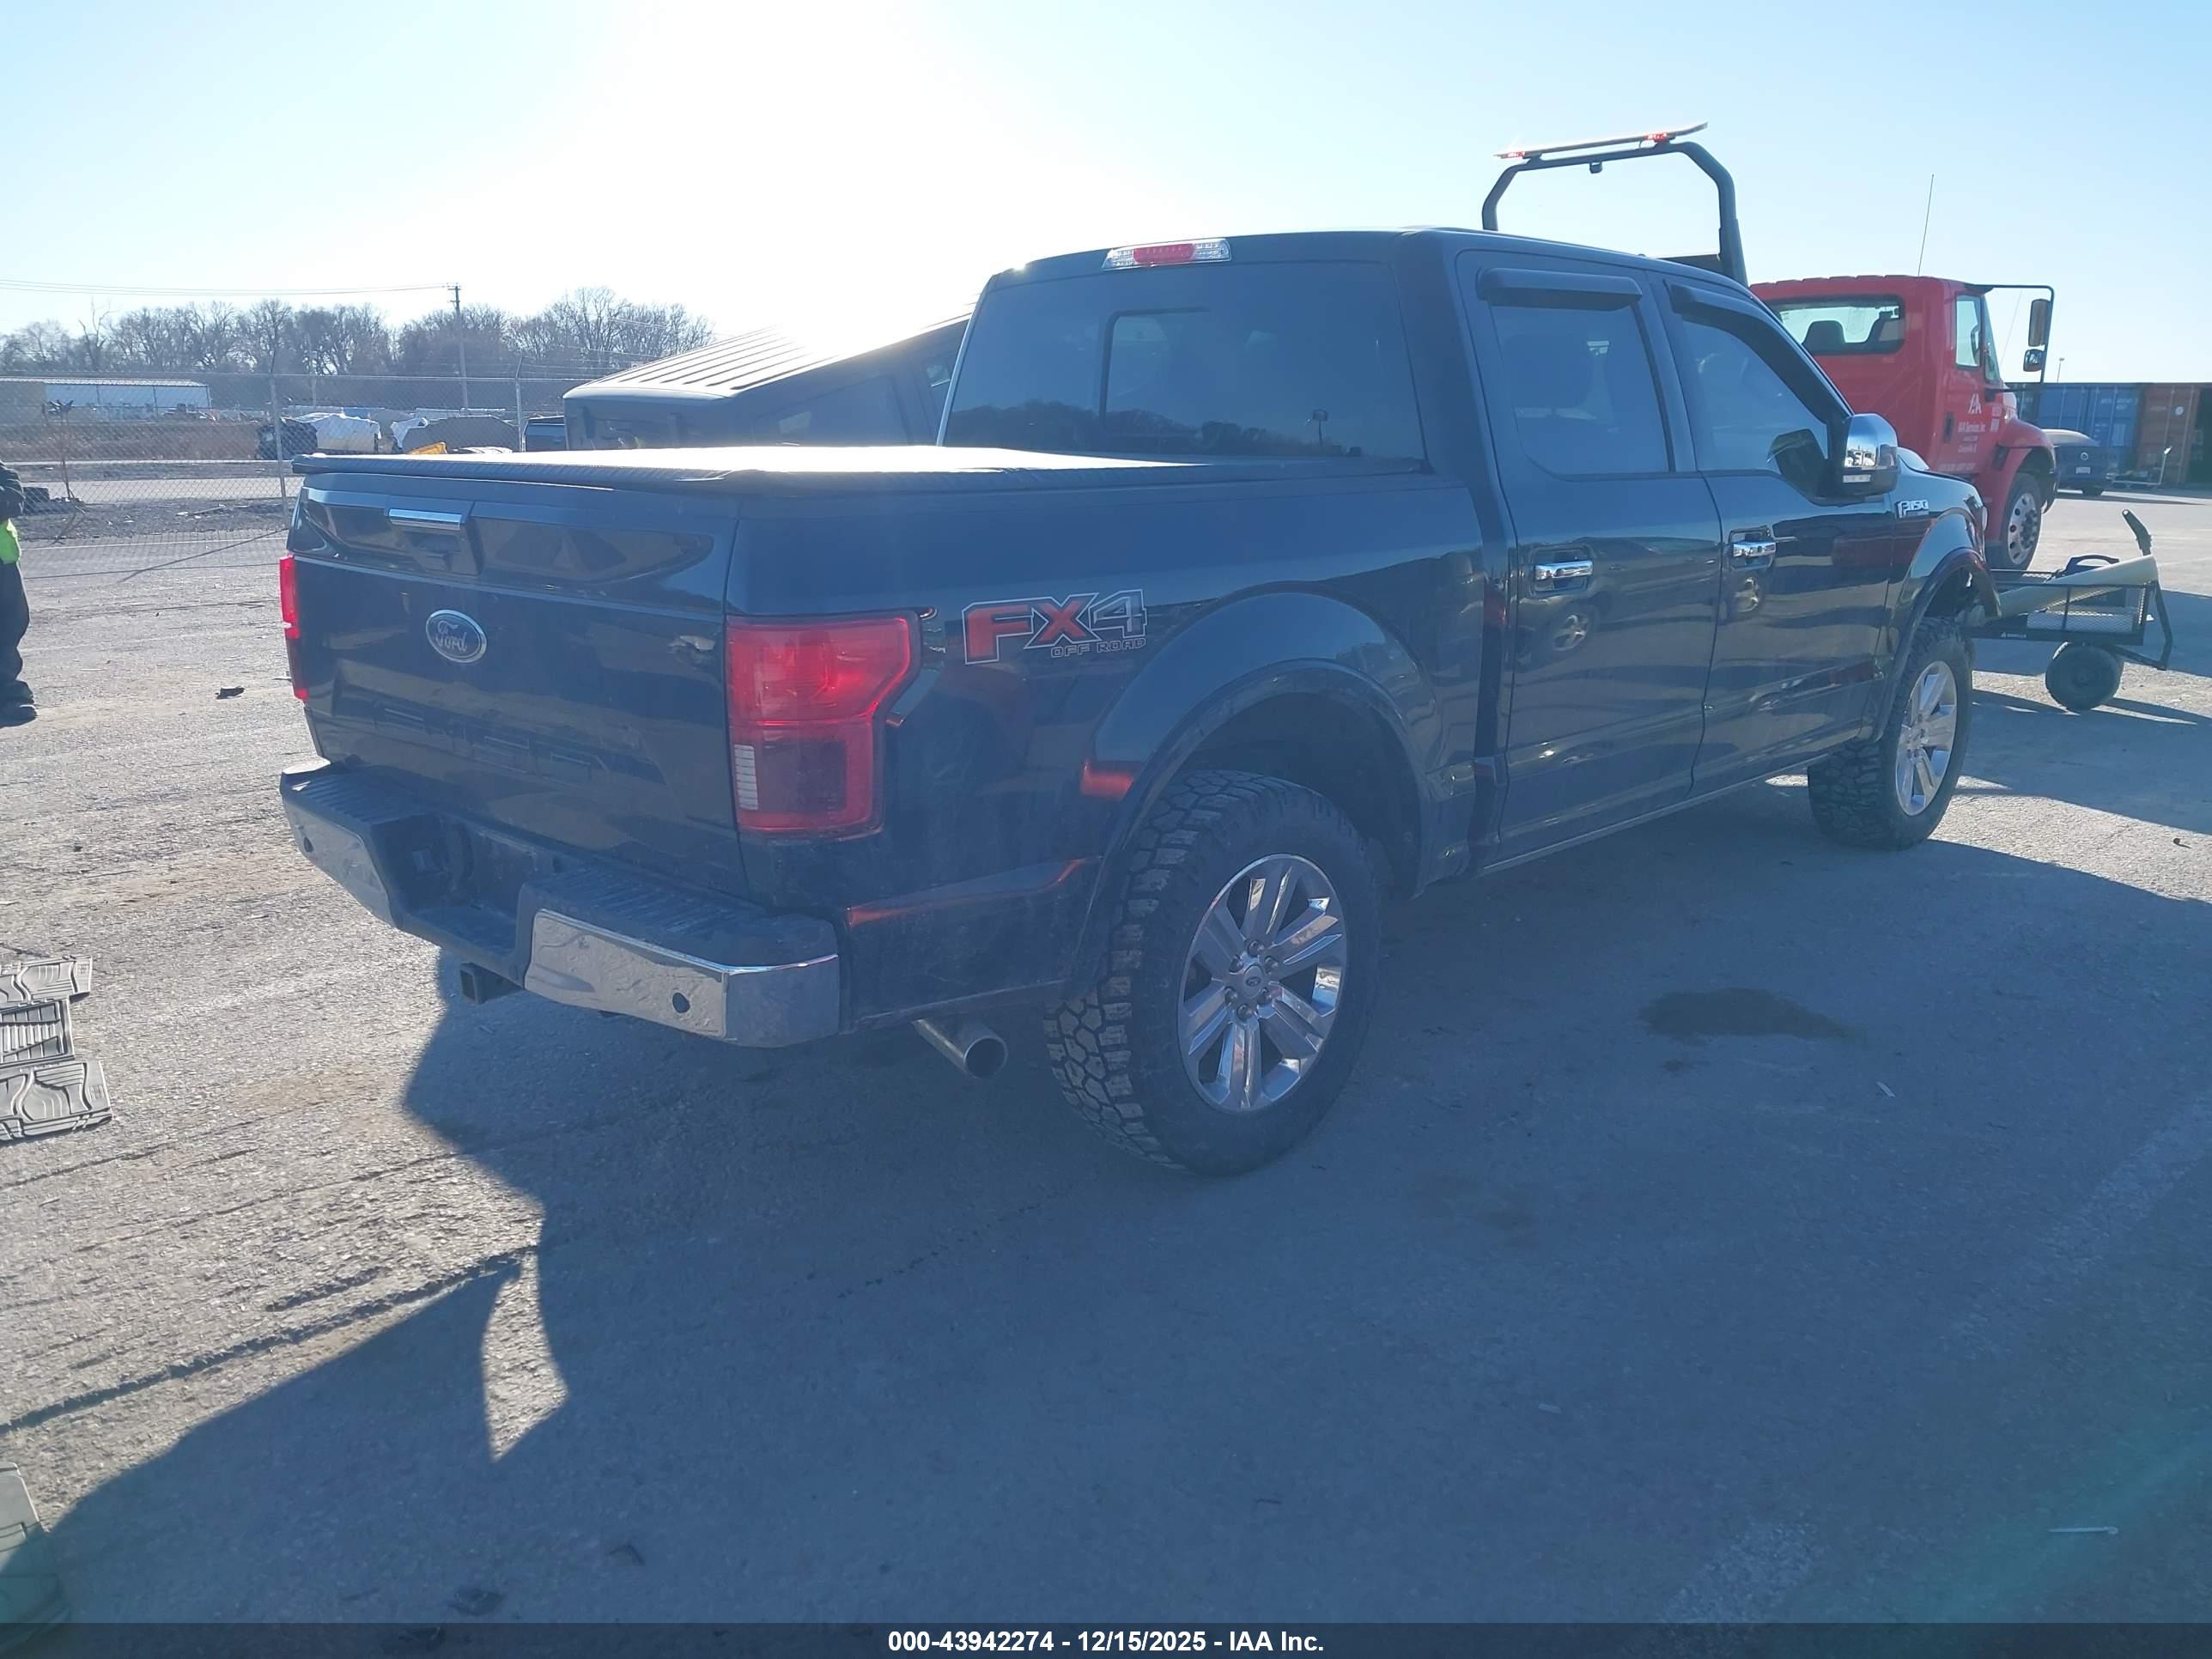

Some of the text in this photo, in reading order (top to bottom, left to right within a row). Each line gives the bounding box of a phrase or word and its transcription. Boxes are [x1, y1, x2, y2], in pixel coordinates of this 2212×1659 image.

[435, 620, 467, 653] Ford
[962, 589, 1147, 665] FX4
[1050, 638, 1146, 659] OFF ROAD
